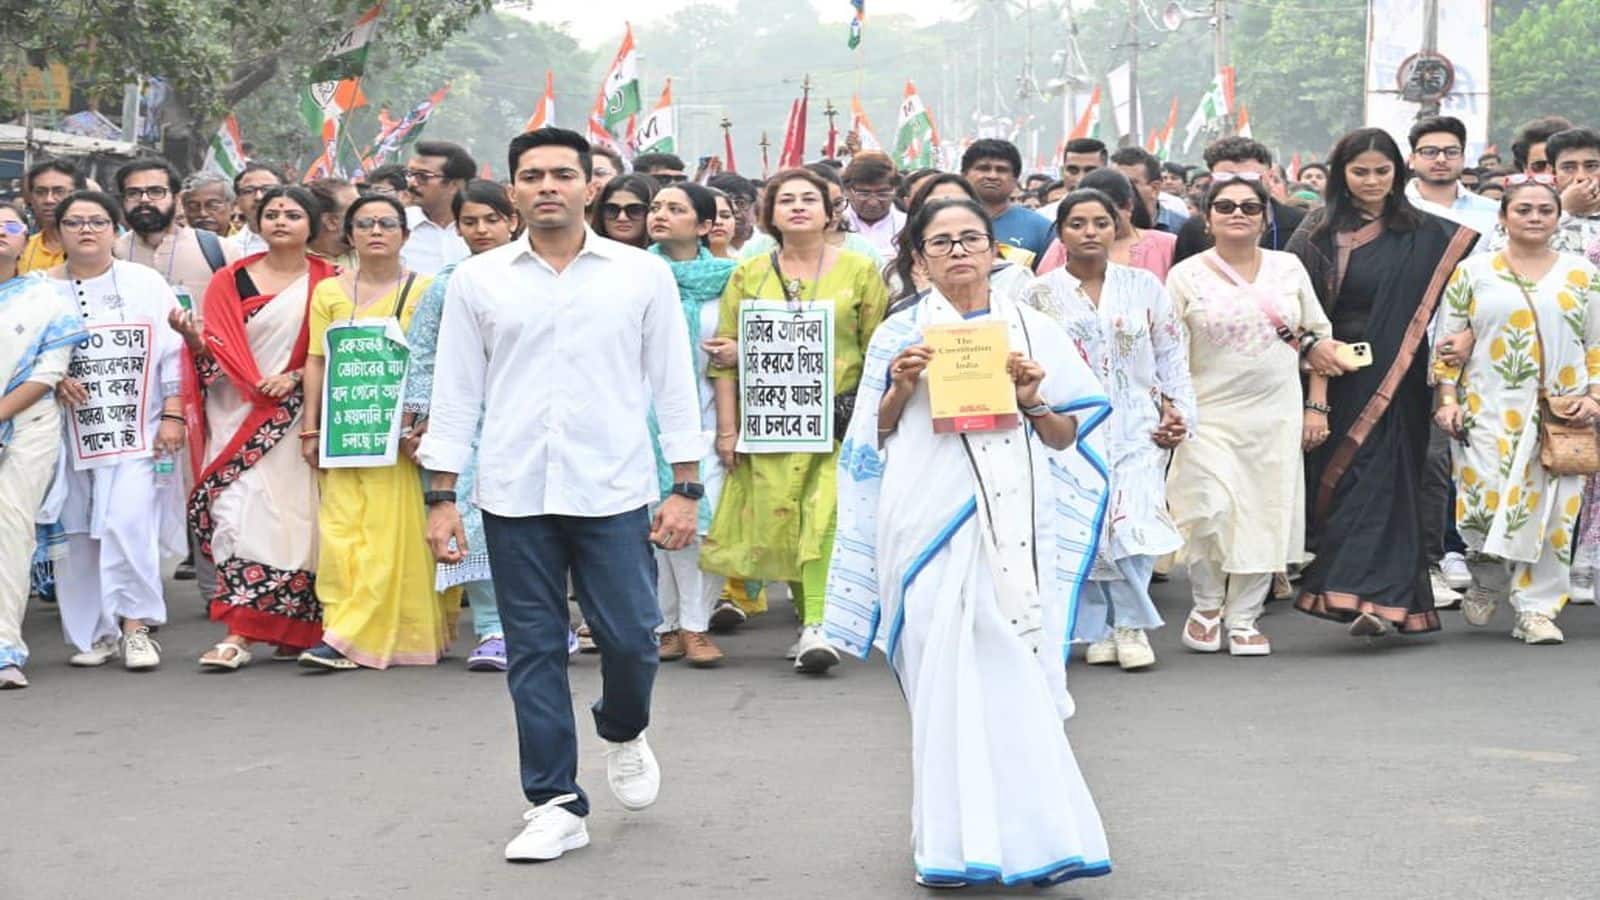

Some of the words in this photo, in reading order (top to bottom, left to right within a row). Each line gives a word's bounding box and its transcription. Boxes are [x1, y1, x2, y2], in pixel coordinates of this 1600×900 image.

[778, 315, 822, 342] তালিকা
[110, 329, 145, 349] ভাগ
[337, 358, 385, 377] ভোটারের
[761, 351, 794, 374] করতে
[798, 345, 824, 374] গিয়ে
[351, 384, 379, 402] গেলে
[791, 380, 822, 407] যাচাই
[334, 411, 341, 425] ও
[765, 415, 802, 437] চলবে
[806, 415, 822, 437] না
[81, 431, 116, 451] পাশে
